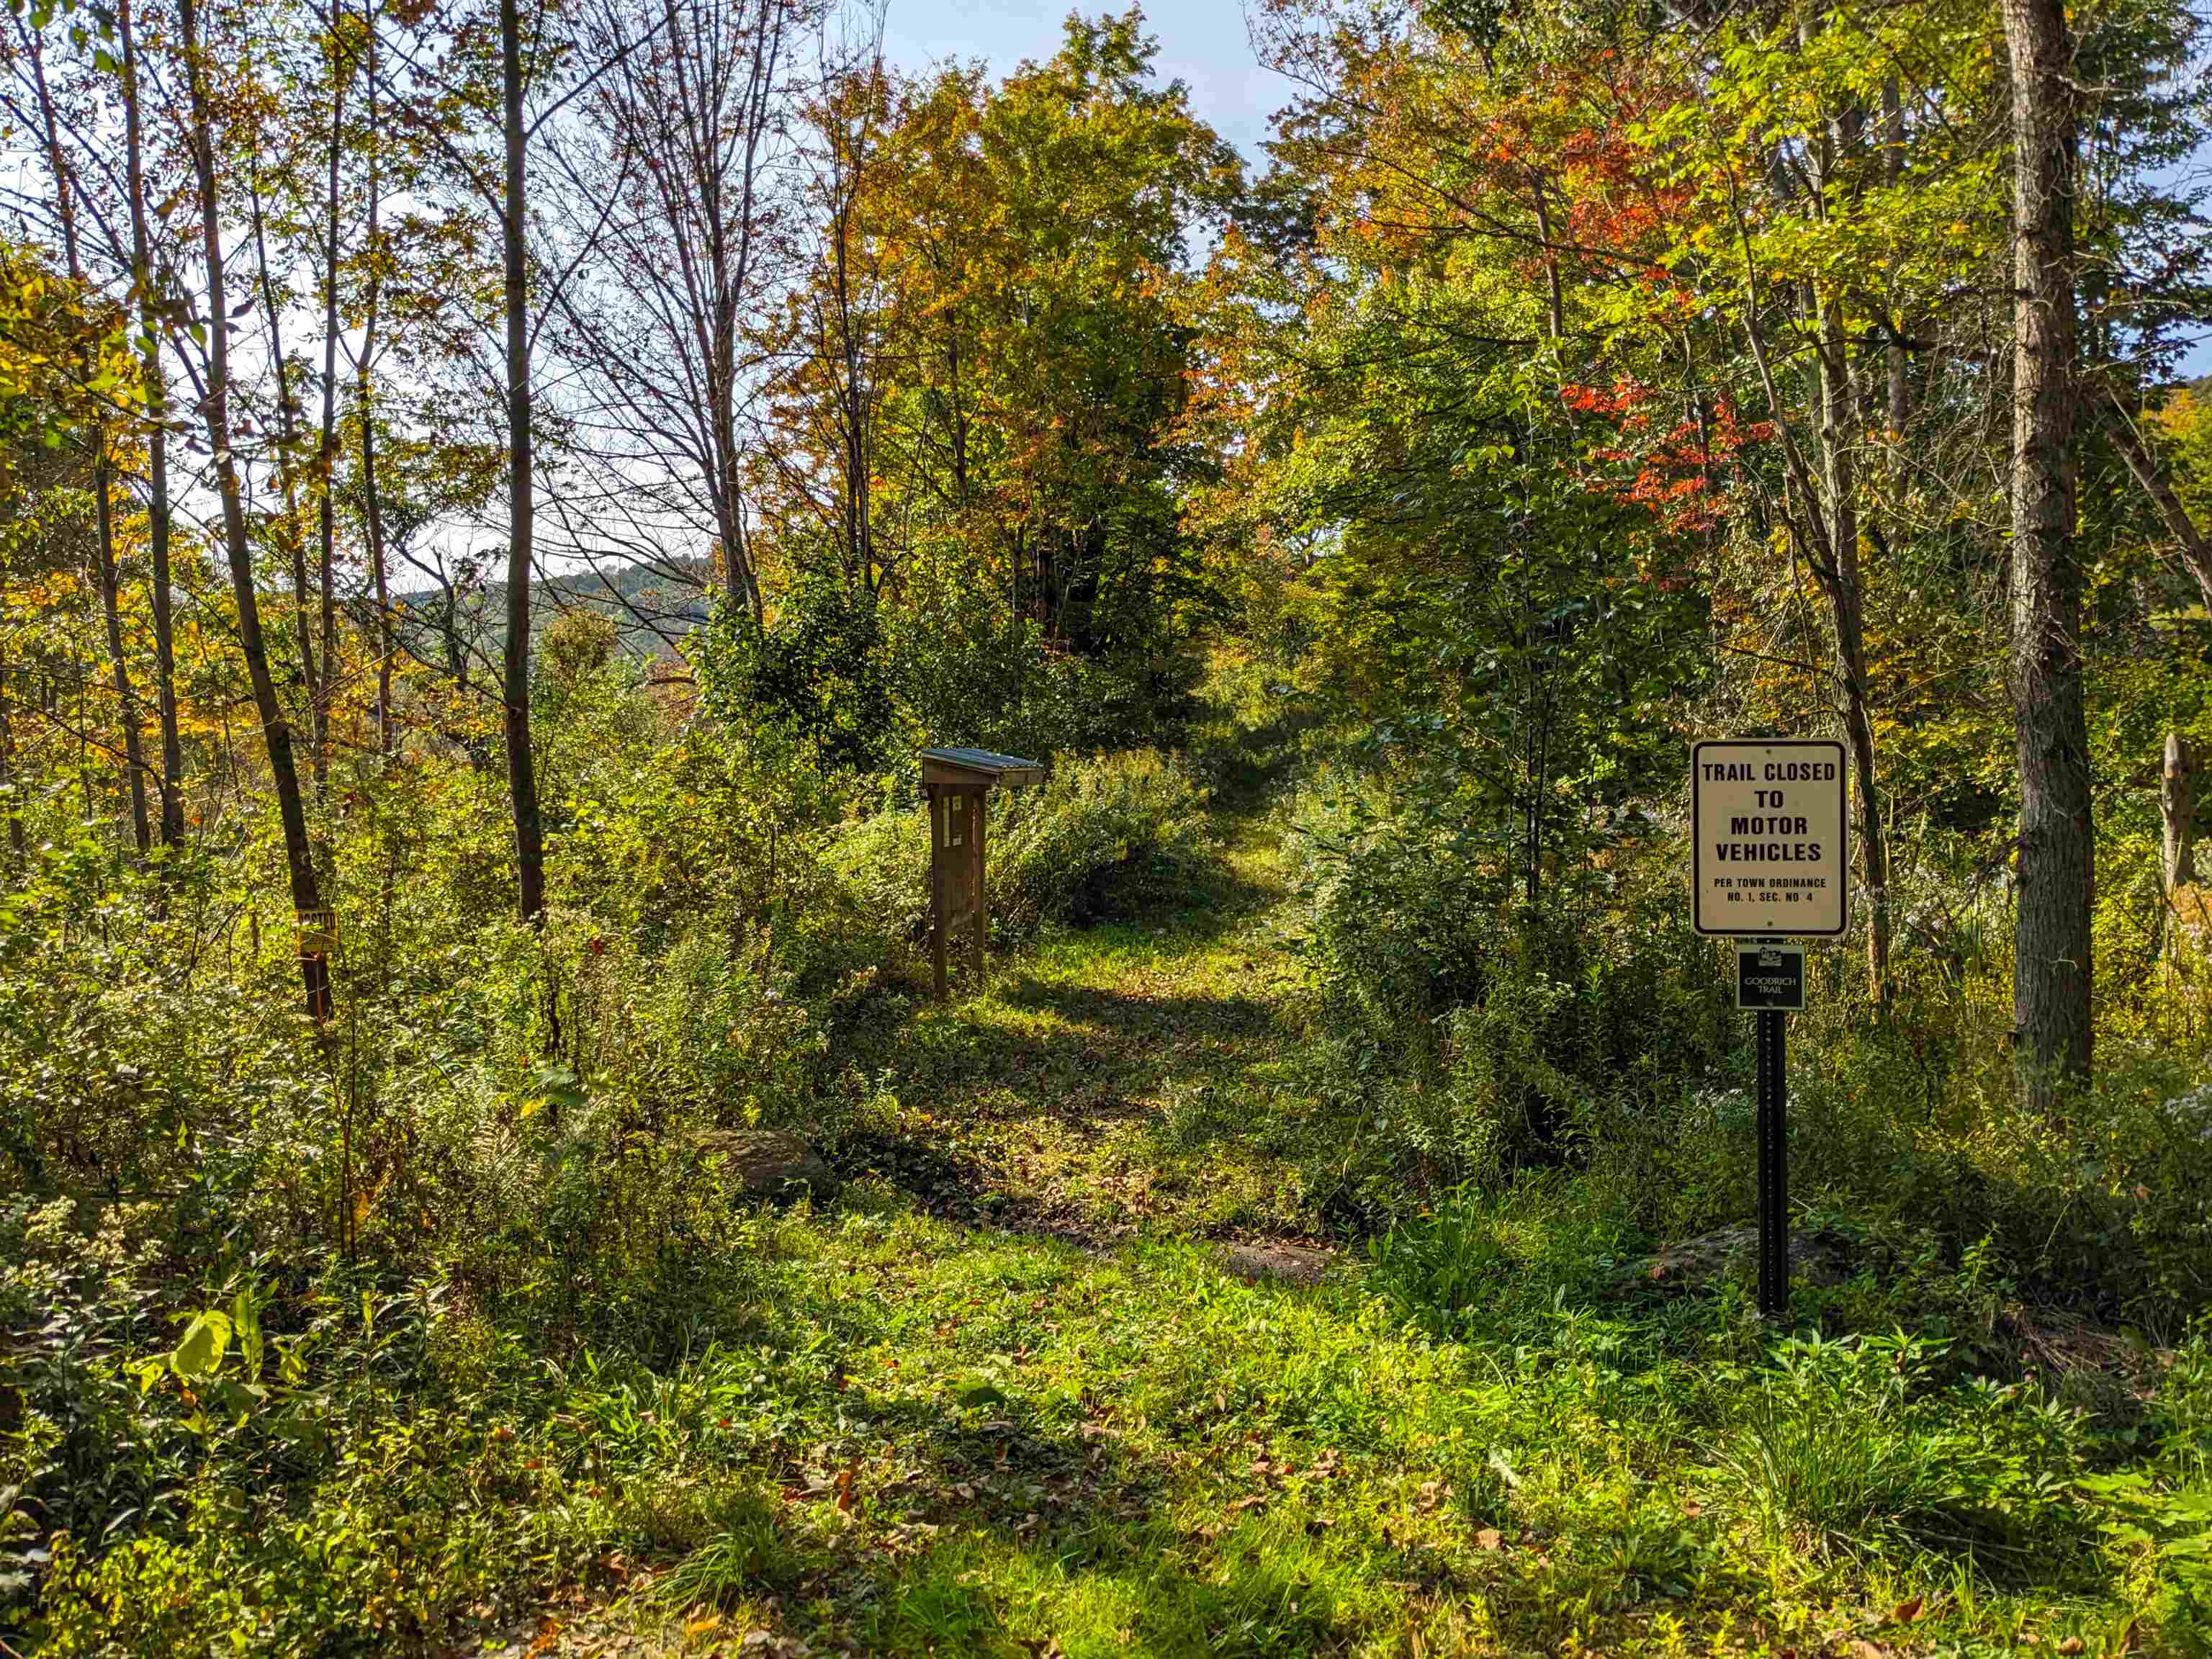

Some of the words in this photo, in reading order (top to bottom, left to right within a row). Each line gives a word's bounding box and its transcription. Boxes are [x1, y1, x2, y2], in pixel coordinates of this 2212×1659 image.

[1701, 763, 1756, 781] TRAIL
[1764, 763, 1835, 781] CLOSED
[1754, 790, 1784, 809] TO
[1731, 817, 1807, 835] MOTOR
[1716, 843, 1821, 861] VEHICLES
[1714, 878, 1732, 888] PER
[1737, 878, 1764, 888] TOWN
[1769, 878, 1827, 888] ORDINANCE
[1727, 892, 1744, 902] NO.
[1759, 892, 1781, 902] SEC.
[1807, 892, 1813, 902] 4
[1745, 977, 1797, 986] GOODRICH
[1758, 985, 1783, 994] TRAIL
